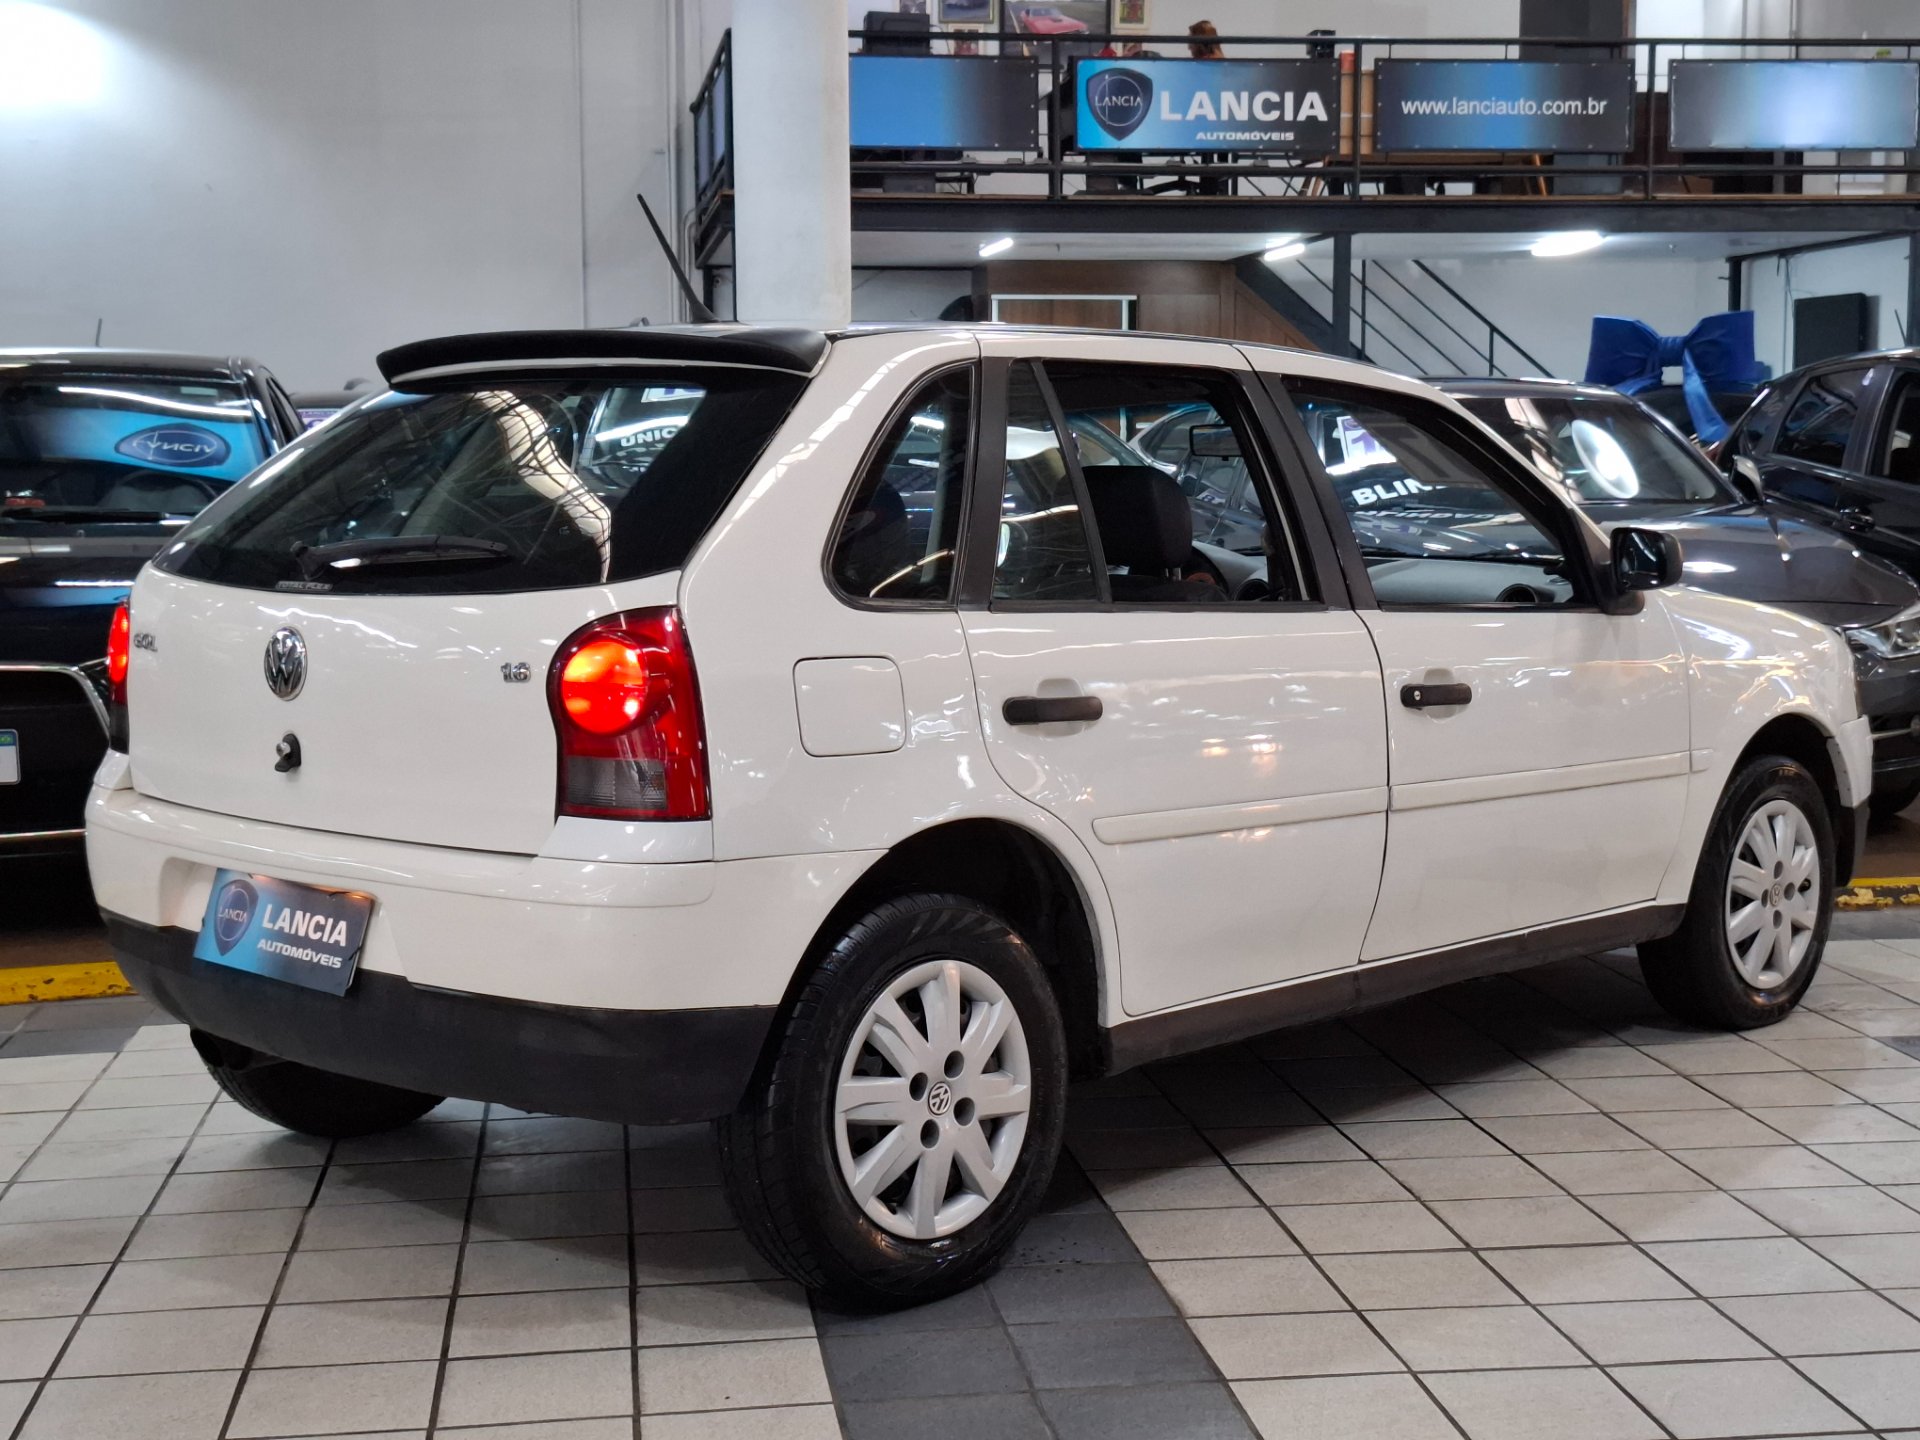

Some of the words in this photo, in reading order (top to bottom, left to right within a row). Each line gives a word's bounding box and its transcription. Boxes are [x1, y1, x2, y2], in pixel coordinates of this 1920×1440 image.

[1094, 95, 1143, 107] LANCIA
[1160, 90, 1329, 122] LANCIA
[1401, 96, 1608, 116] www.lanciauto.com.br
[1195, 129, 1295, 141] AUTOMÓVEIS
[1351, 478, 1447, 506] BLIN
[218, 907, 248, 922] LANCIA
[262, 904, 348, 947] LANCIA
[257, 939, 343, 969] AUTOMÓVEIS
